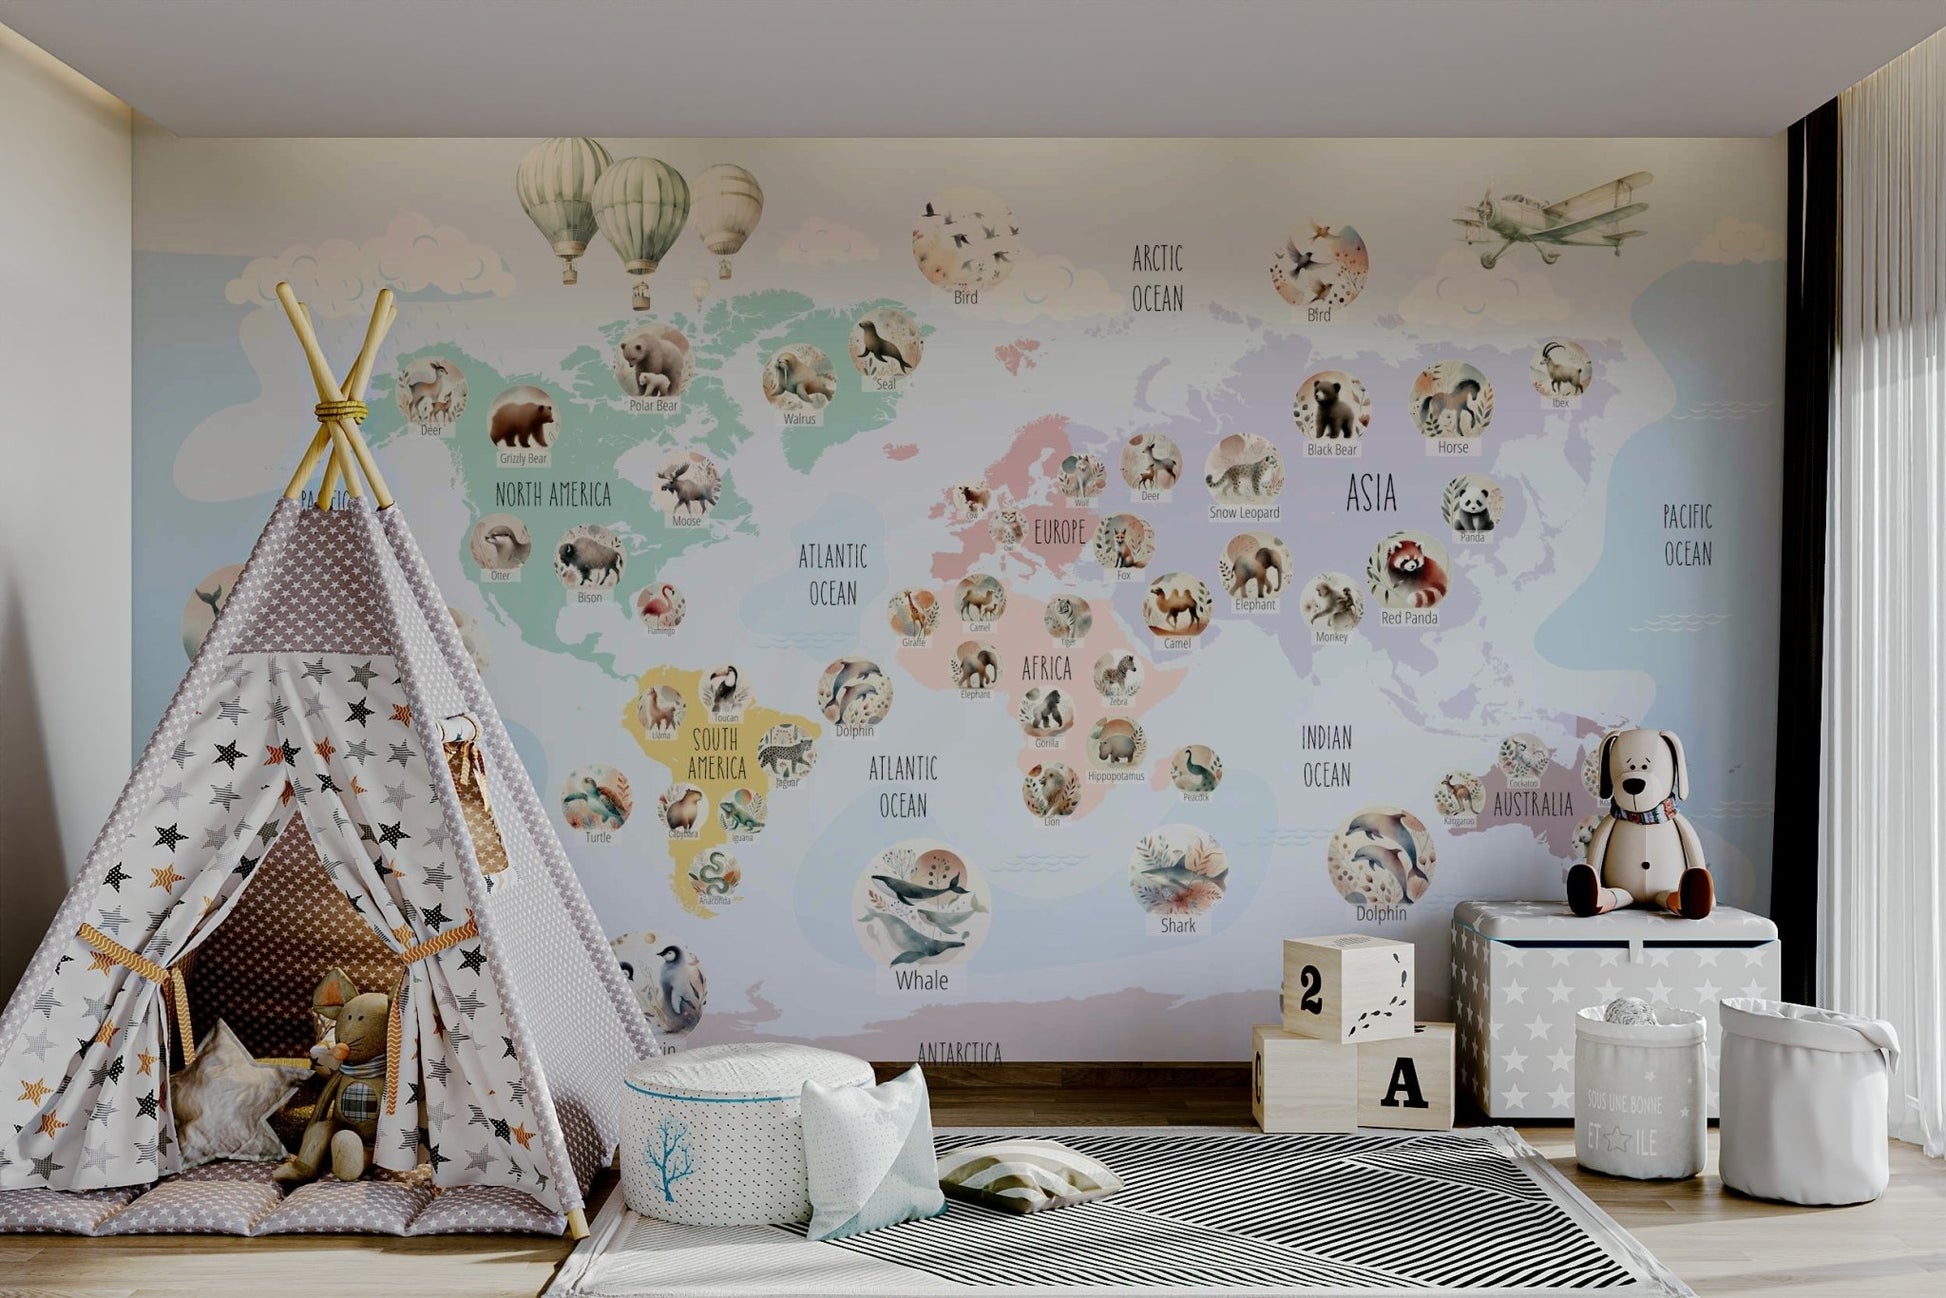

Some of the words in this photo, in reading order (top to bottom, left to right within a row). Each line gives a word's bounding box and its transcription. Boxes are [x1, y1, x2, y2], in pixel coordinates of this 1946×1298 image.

[1132, 244, 1183, 272] ARCTIC
[954, 290, 978, 304] Bird
[1132, 284, 1183, 312] OCEAN
[1308, 307, 1331, 322] Bird
[876, 378, 896, 390] Seal
[630, 399, 654, 411] Polar
[656, 399, 678, 411] Bear
[1552, 398, 1570, 408] Ibex
[784, 413, 816, 425] Walrus
[421, 424, 442, 436] Deer
[1308, 443, 1333, 456] Black
[1335, 443, 1357, 456] Bear
[1438, 441, 1469, 454] Horse
[500, 453, 526, 467] Grizzly
[528, 453, 547, 465] Bear
[496, 482, 542, 507] NORTH
[548, 482, 612, 507] AMERICA
[1141, 490, 1160, 501] Deer
[1346, 473, 1397, 512] ASIA
[1210, 507, 1236, 519] Snow
[1239, 506, 1280, 522] Leopard
[1664, 504, 1713, 529] PACIFIC
[673, 515, 701, 527] Moose
[1035, 519, 1085, 544] EUROPE
[1460, 532, 1484, 542] Panda
[799, 544, 867, 569] ATLANTIC
[1665, 541, 1712, 566] OCEAN
[491, 571, 510, 581] Otter
[1117, 571, 1131, 580] Fox
[578, 591, 602, 603] Bison
[810, 581, 857, 606] OCEAN
[1235, 598, 1275, 612] Elephant
[1382, 612, 1402, 624] Red
[1405, 612, 1438, 624] Panda
[970, 624, 991, 632] Camel
[902, 638, 926, 647] Giraffe
[1061, 638, 1076, 648] Tiger
[1164, 638, 1191, 649] Camel
[1316, 631, 1348, 644] Monkey
[1022, 655, 1072, 680] AFRICA
[960, 689, 991, 701] Elephant
[1109, 697, 1128, 706] Zebra
[714, 713, 739, 723] Toucan
[836, 724, 874, 740] Dolphin
[1302, 725, 1352, 750] INDIAN
[693, 728, 738, 751] SOUTH
[1035, 738, 1059, 748] Gorilla
[688, 756, 746, 780] AMERICA
[869, 756, 938, 781] ATLANTIC
[1304, 762, 1351, 787] OCEAN
[775, 778, 800, 789] Jaguar
[1088, 771, 1145, 783] Hippopotamus
[1509, 780, 1538, 788] Cockatoo
[880, 793, 928, 818] OCEAN
[1494, 792, 1573, 817] AUSTRALIA
[1044, 817, 1060, 827] Lion
[1444, 817, 1475, 827] Kangaroo
[586, 831, 611, 843] Turtle
[732, 833, 753, 843] Iguana
[1356, 905, 1407, 926] Dolphin
[1161, 918, 1196, 934] Shark
[895, 971, 948, 990] Whale
[1300, 964, 1322, 1015] 2
[917, 1042, 1002, 1067] ANTARCTICA
[1380, 1057, 1429, 1109] A
[1588, 1088, 1607, 1110] SOUS
[1609, 1094, 1627, 1113] UNE
[1630, 1096, 1663, 1114] BONNE
